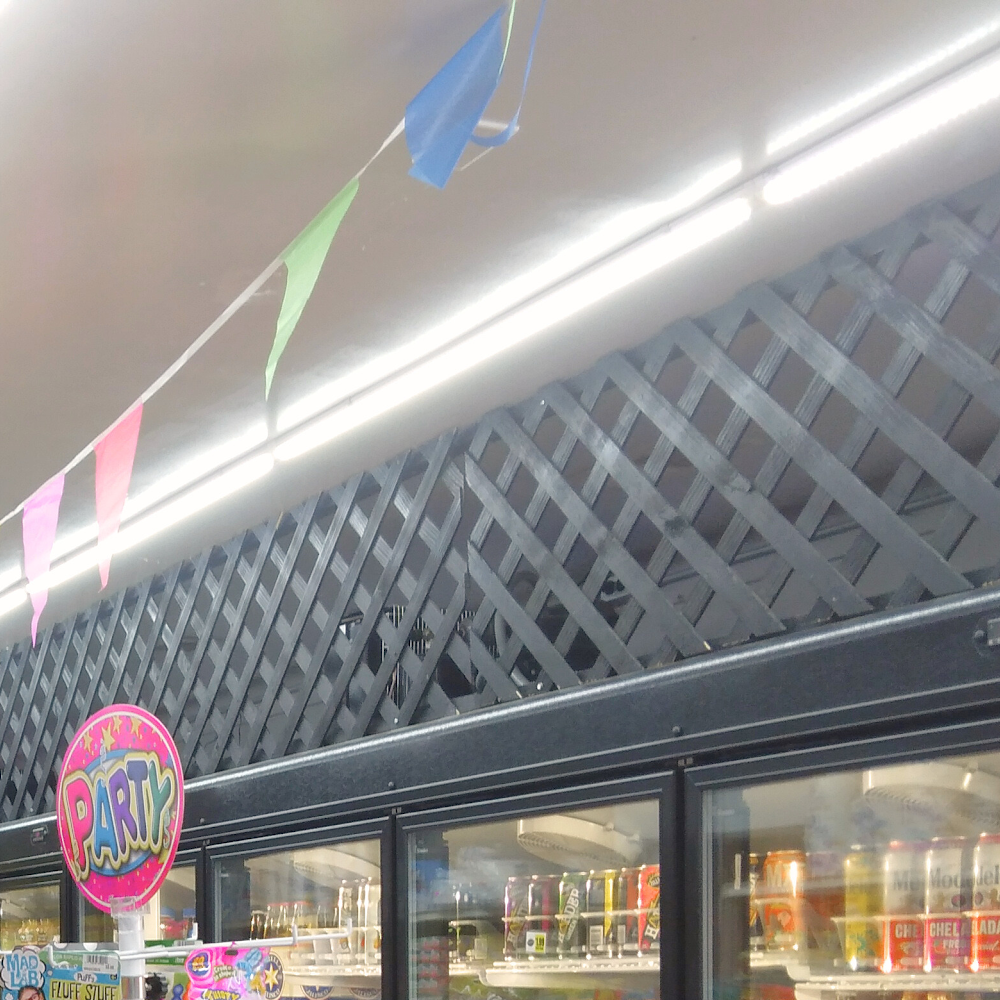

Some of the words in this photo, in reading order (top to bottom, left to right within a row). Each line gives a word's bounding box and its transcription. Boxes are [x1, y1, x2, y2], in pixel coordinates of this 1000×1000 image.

[64, 750, 177, 873] PARTY
[6, 953, 39, 977] MAD
[10, 970, 39, 988] LAB
[51, 981, 82, 1000] FLUFF
